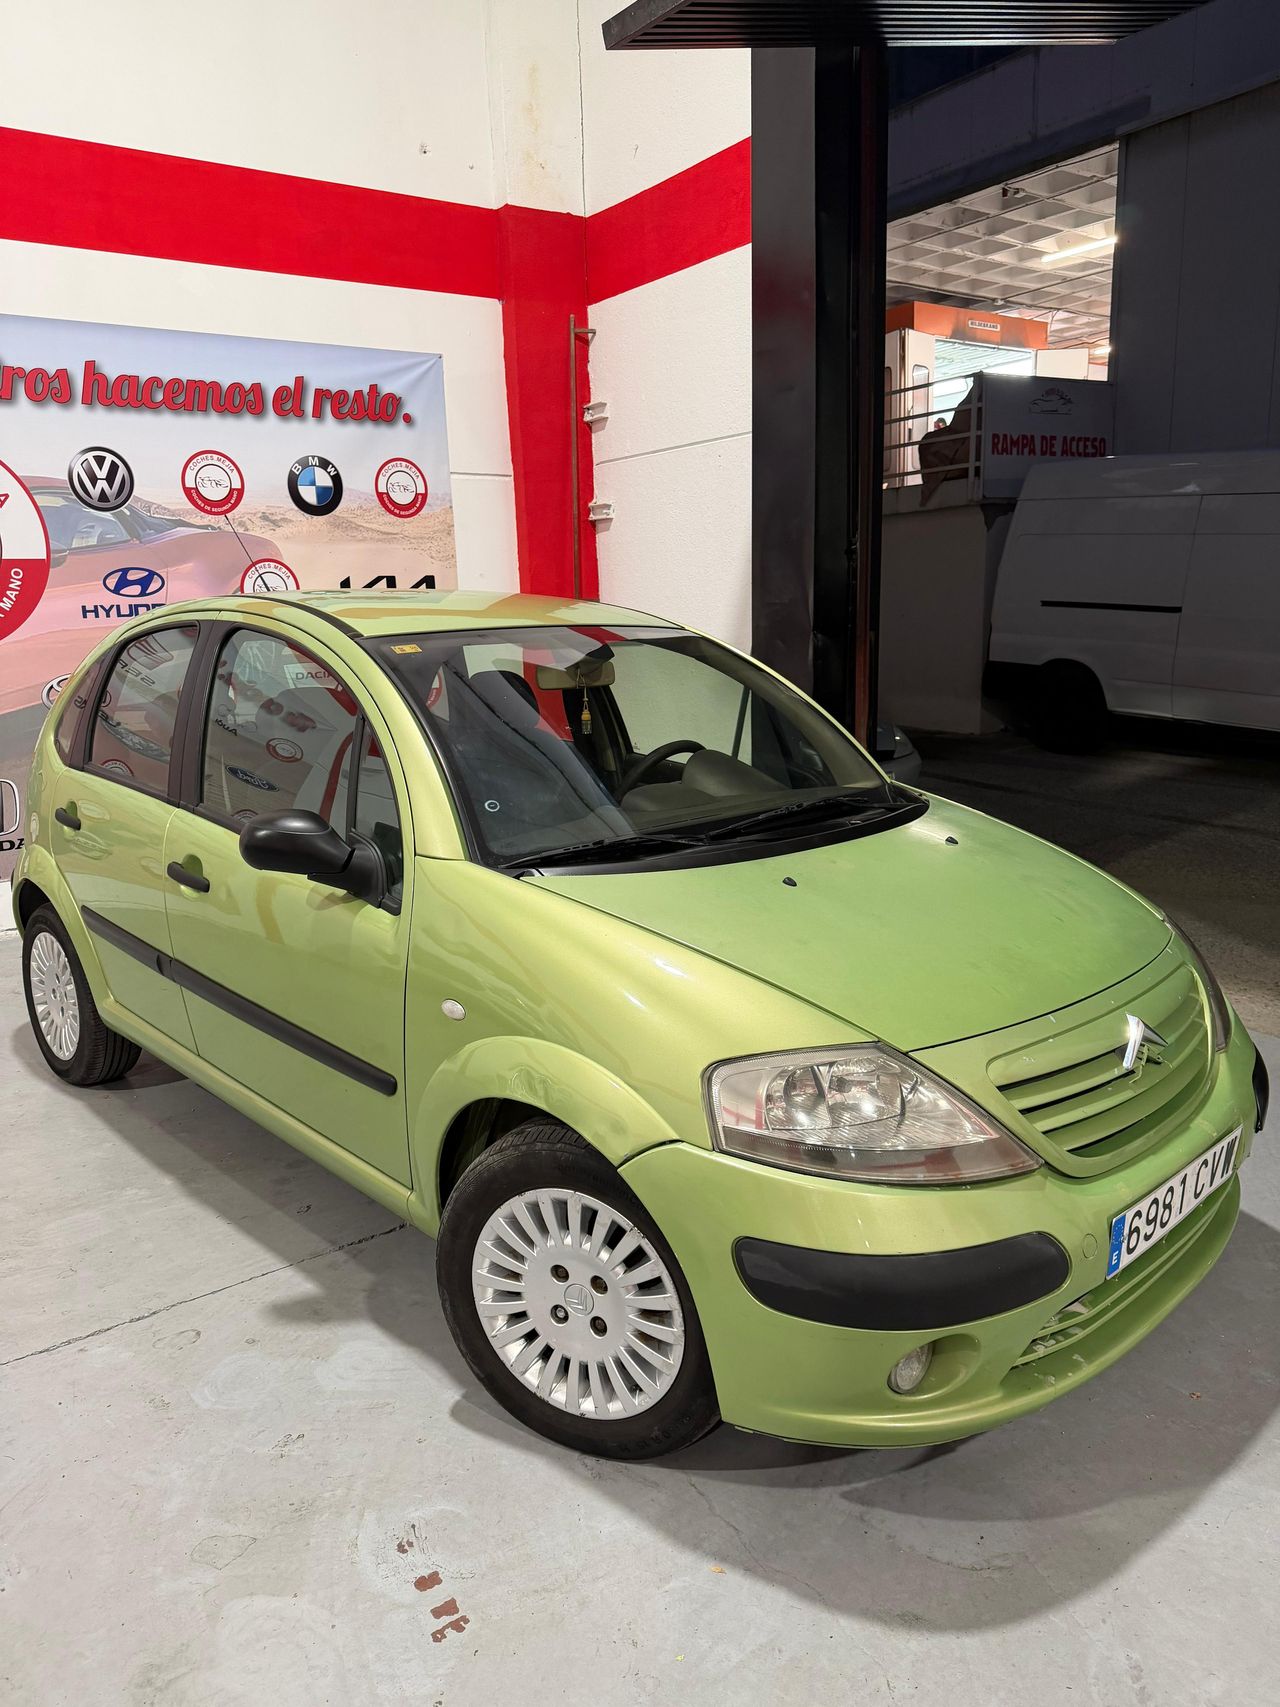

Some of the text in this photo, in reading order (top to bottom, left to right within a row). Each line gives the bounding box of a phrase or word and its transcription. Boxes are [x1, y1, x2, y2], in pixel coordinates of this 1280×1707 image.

[0, 360, 412, 424] ros hacemos el resto.
[991, 433, 1106, 458] RAMPA DE ACCESO
[189, 455, 235, 473] COCHES MEJIA
[291, 456, 337, 476] BMW
[382, 462, 403, 477] COCHES
[0, 568, 24, 612] MANO
[81, 603, 167, 619] HYUN
[295, 671, 330, 680] DACI
[1126, 1135, 1238, 1255] 6981 CVW
[1111, 1251, 1119, 1266] E
